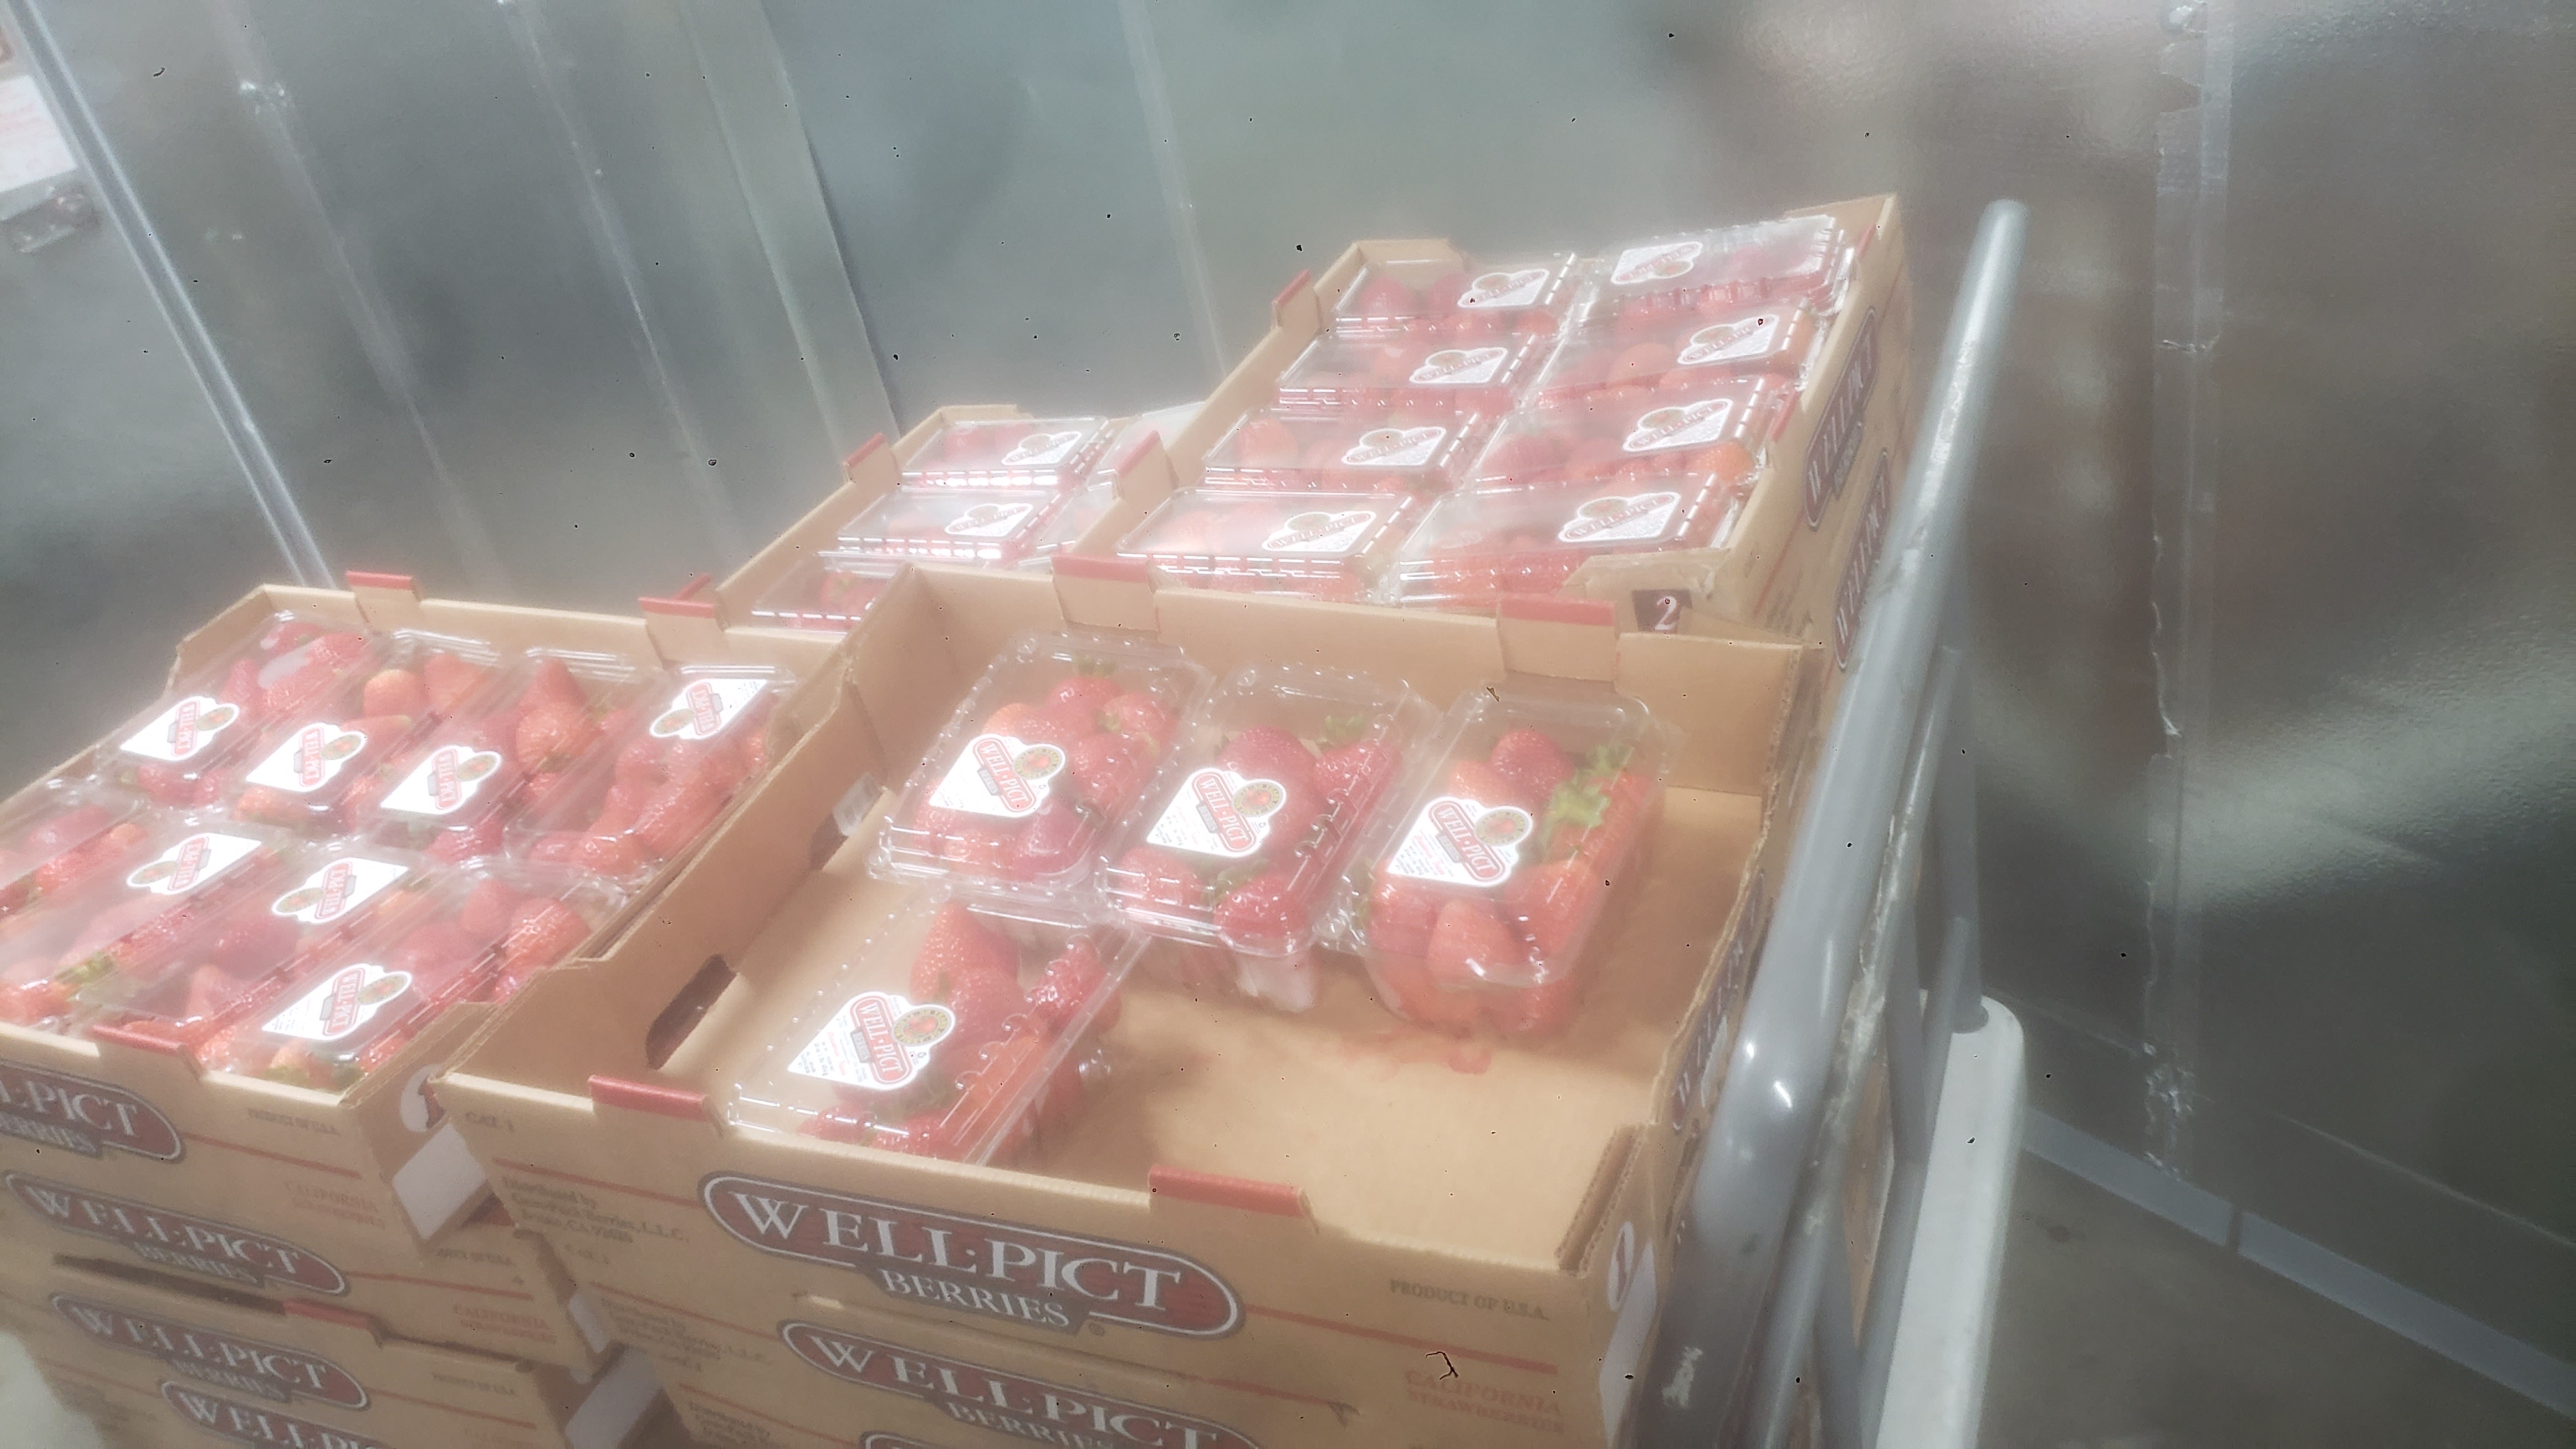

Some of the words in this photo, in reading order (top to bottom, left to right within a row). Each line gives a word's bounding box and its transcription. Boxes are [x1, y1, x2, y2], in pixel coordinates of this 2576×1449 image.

[1654, 595, 1677, 631] 2
[0, 1078, 139, 1139] L·PICT
[879, 1268, 1070, 1328] BERRIES
[947, 1400, 1113, 1449] BERRIE
